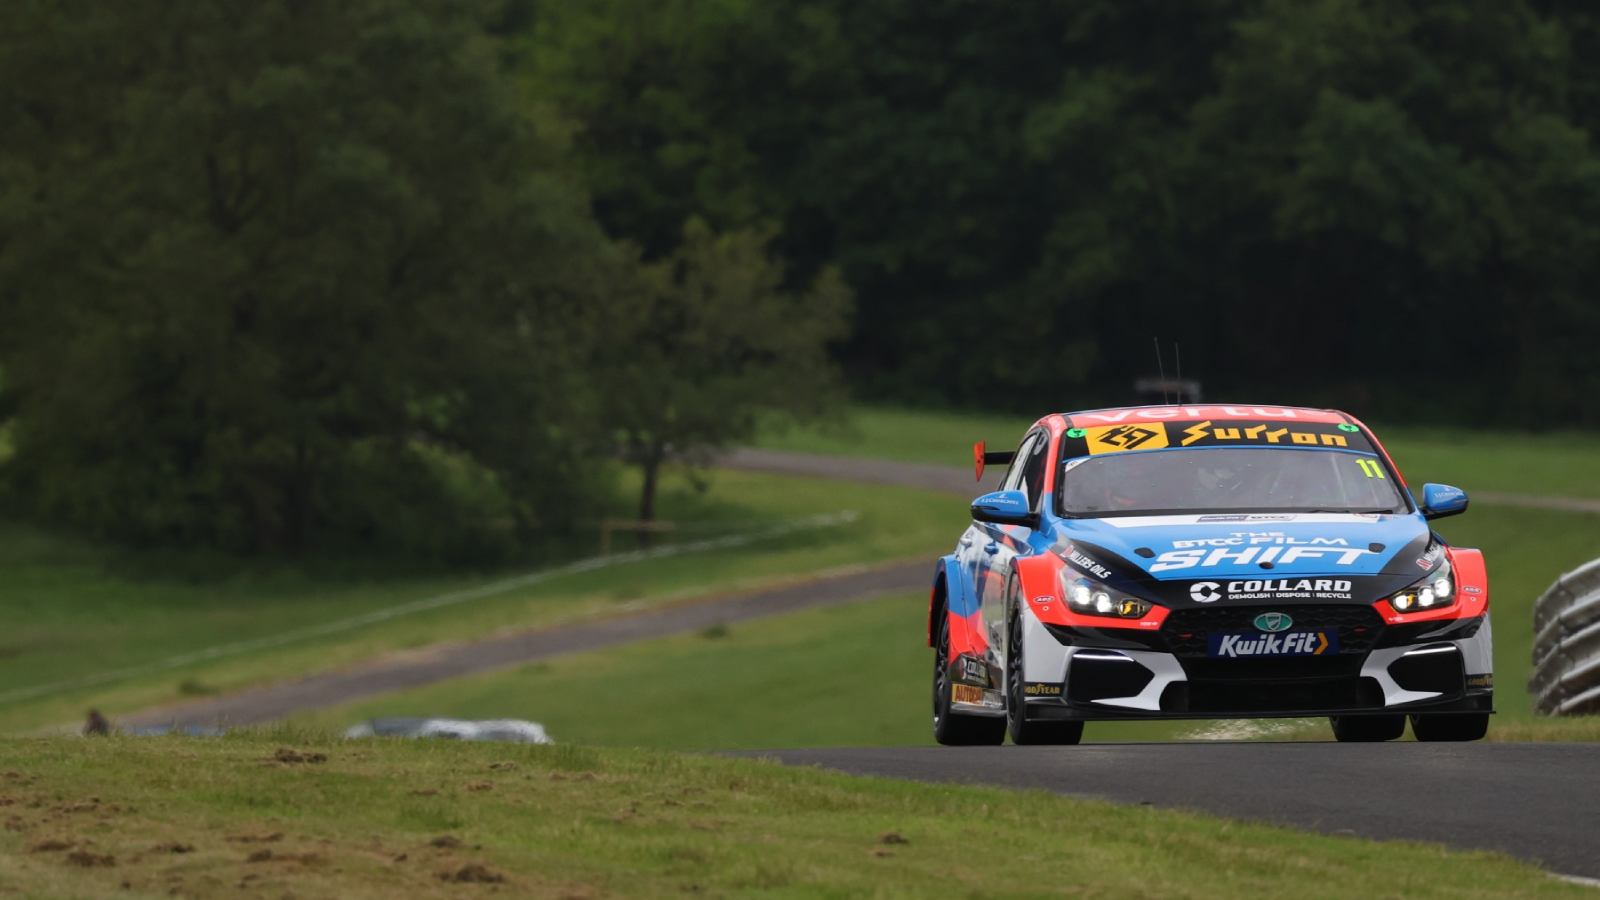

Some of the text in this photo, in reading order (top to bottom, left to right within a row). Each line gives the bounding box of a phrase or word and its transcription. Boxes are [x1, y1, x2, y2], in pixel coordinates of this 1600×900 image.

[1355, 458, 1385, 479] 11
[1172, 537, 1349, 550] BTCC FILM
[1149, 546, 1382, 573] SHIFT
[1089, 564, 1112, 579] OILS
[1227, 579, 1352, 593] COLLARD
[1228, 592, 1271, 600] DEMOLISH
